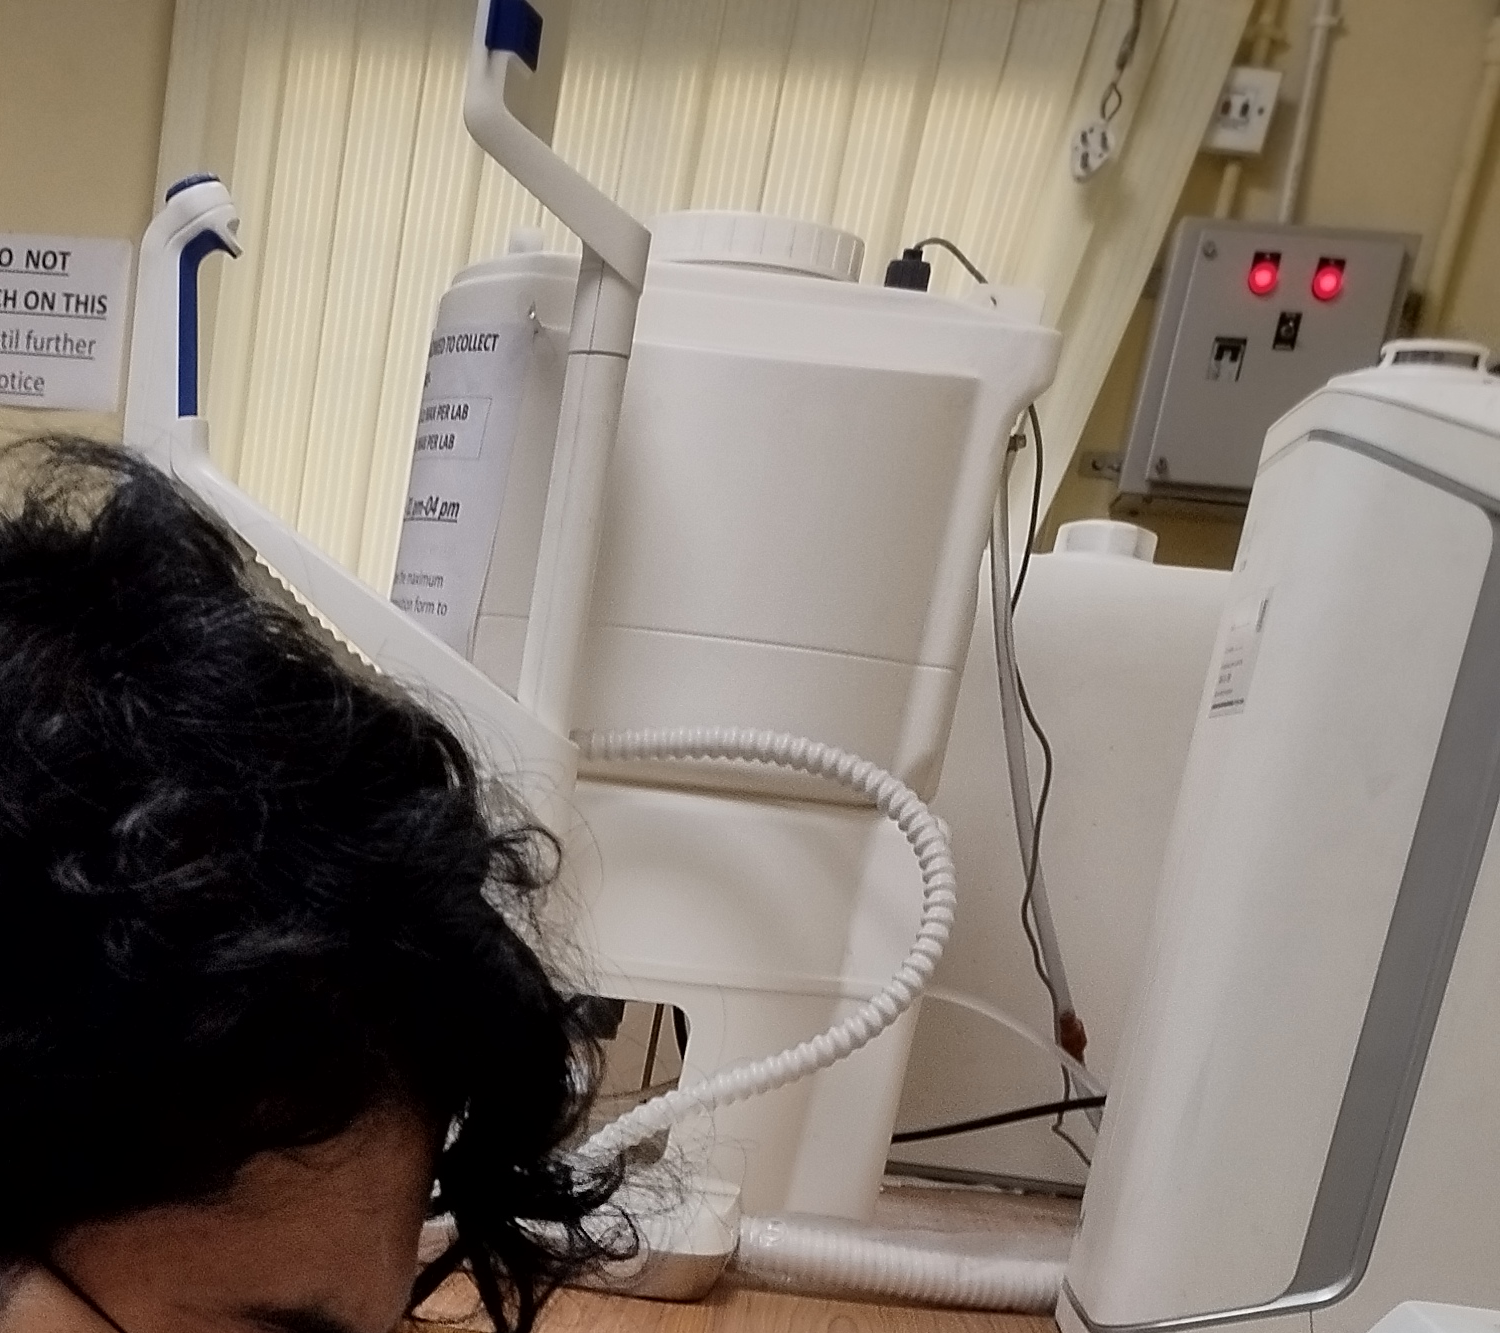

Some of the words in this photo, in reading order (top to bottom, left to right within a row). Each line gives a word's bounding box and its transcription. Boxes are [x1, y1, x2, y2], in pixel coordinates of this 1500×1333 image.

[25, 250, 71, 271] NOT
[24, 290, 56, 311] ON
[62, 293, 107, 315] THIS
[25, 329, 96, 355] further
[455, 333, 500, 352] COLLECT
[437, 404, 451, 420] PER
[451, 403, 469, 420] LAB
[439, 433, 455, 450] LAB
[438, 501, 460, 520] pm
[414, 596, 435, 615] form
[436, 602, 448, 617] to
